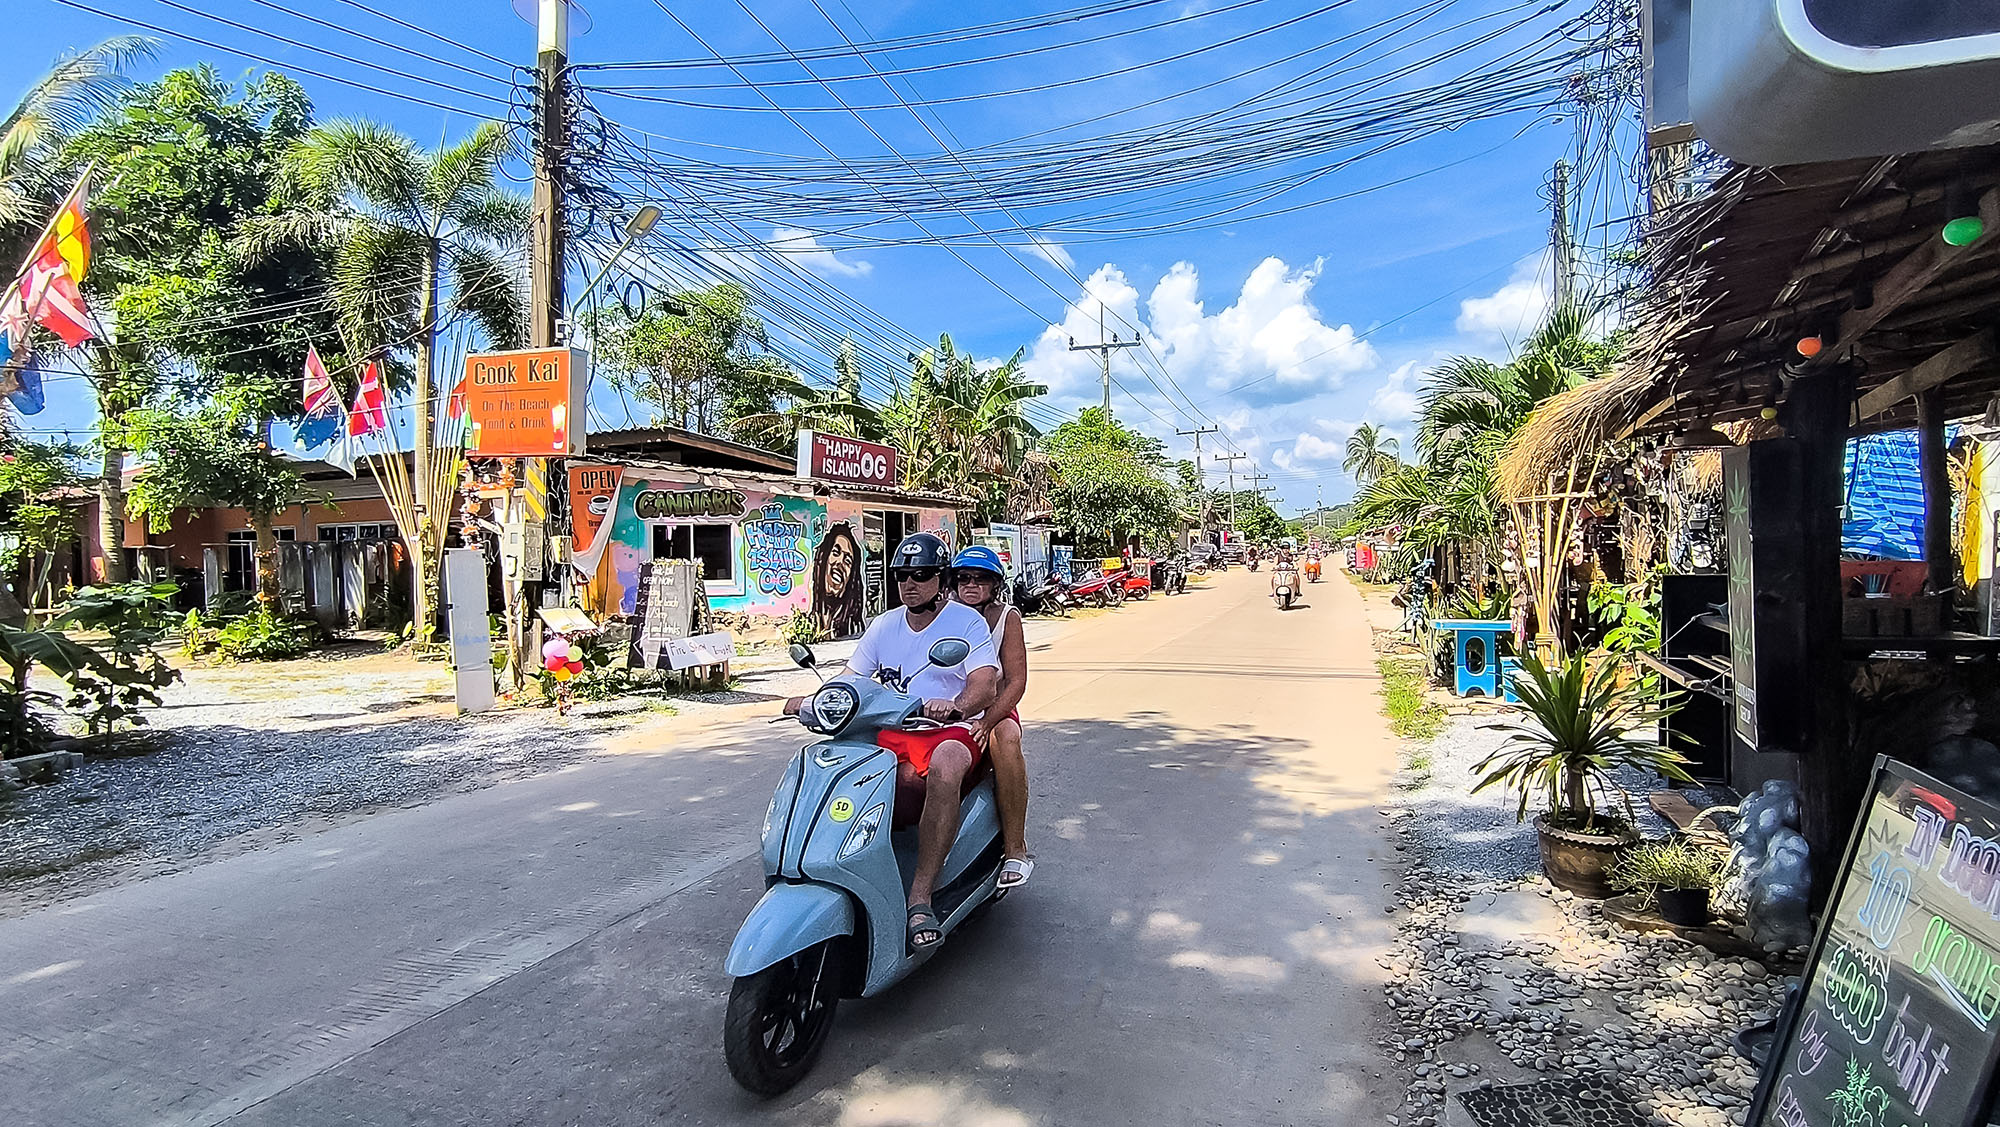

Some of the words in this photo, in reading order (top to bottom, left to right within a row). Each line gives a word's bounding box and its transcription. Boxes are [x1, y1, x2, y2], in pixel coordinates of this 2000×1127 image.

[474, 360, 518, 385] Cook
[528, 357, 559, 382] Kai
[482, 401, 494, 412] On
[500, 400, 515, 411] The
[519, 399, 549, 411] Beach
[483, 418, 505, 430] Food
[521, 417, 546, 429] Drink
[825, 439, 862, 460] HAPPY
[822, 457, 861, 478] ISLAND
[861, 451, 887, 480] OG
[581, 470, 616, 489] OPEN
[636, 489, 747, 518] CANNABIS
[747, 548, 807, 571] ISLAND
[759, 569, 792, 596] OG
[835, 801, 849, 812] SD
[1858, 850, 1912, 949] 10
[1913, 915, 2000, 1021] grams
